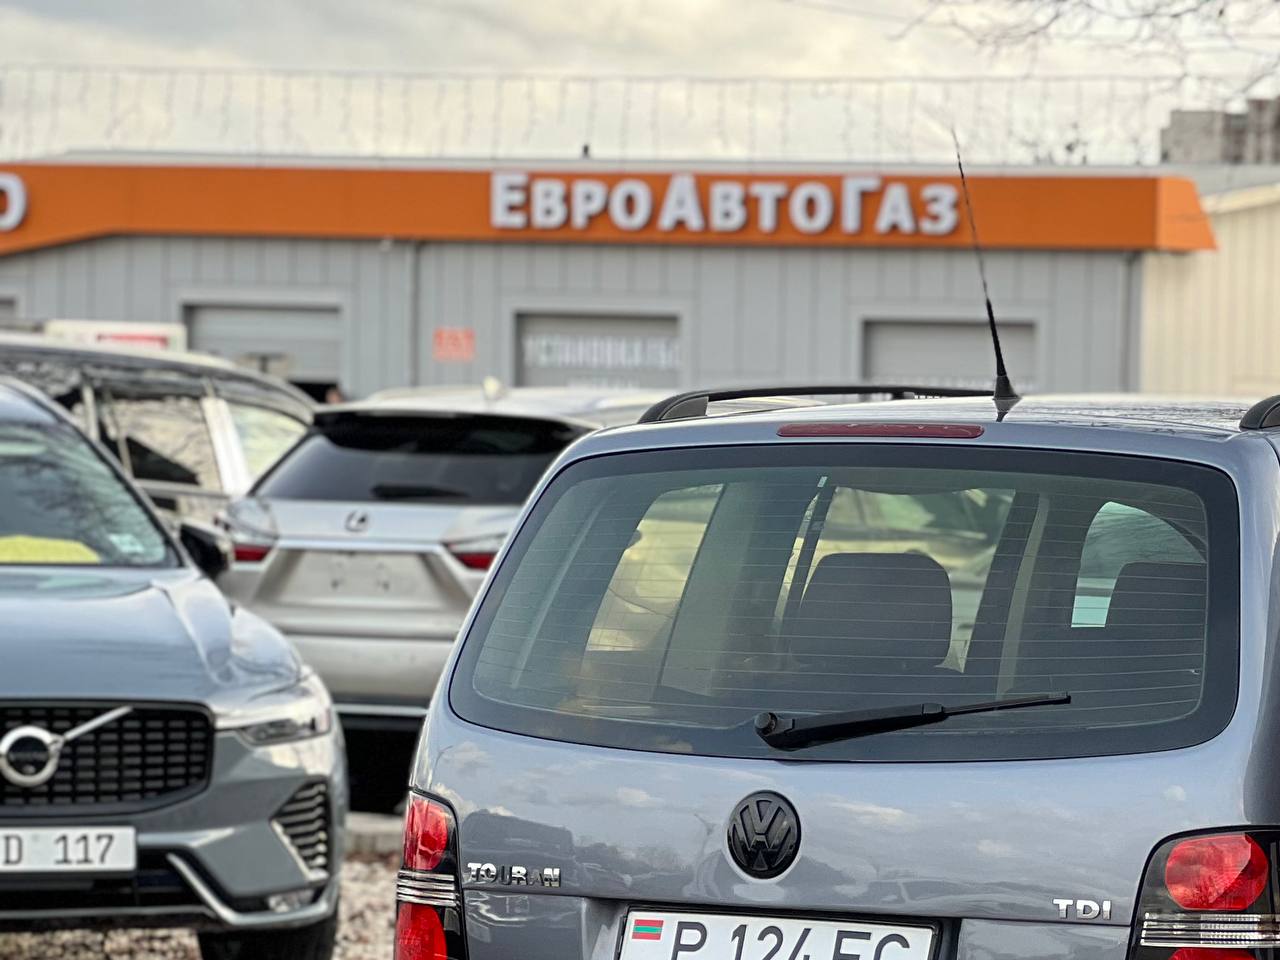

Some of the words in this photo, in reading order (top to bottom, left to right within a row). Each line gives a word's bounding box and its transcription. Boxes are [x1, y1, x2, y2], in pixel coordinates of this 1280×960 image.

[54, 834, 114, 865] 117
[467, 863, 561, 888] TOURAN
[1053, 898, 1112, 920] TDI
